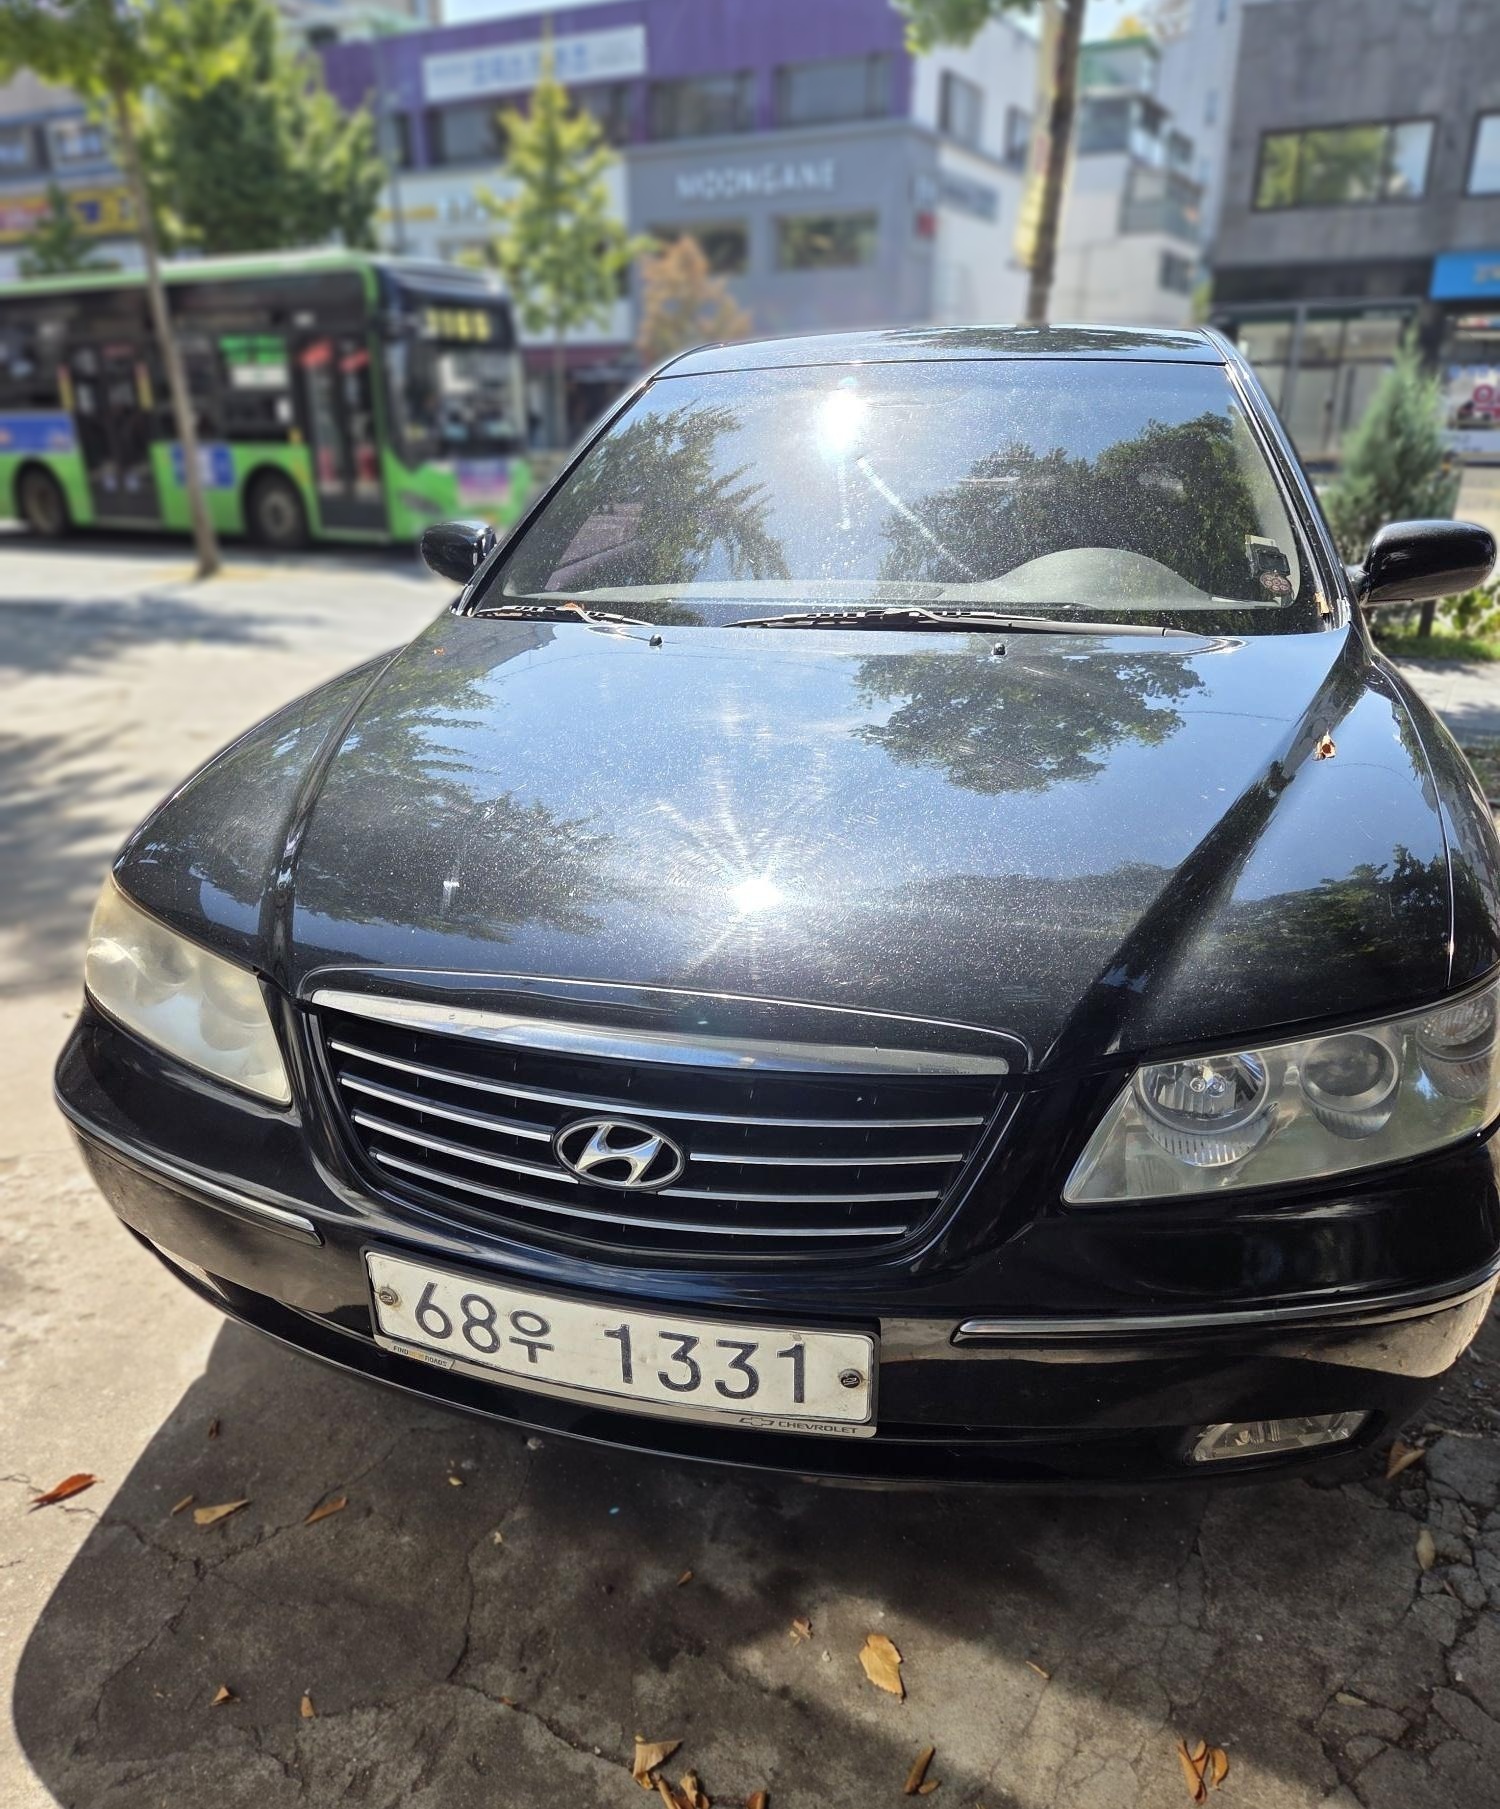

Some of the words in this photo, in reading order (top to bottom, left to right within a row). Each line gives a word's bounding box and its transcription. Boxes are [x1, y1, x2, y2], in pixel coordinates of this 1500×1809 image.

[415, 1281, 555, 1363] 68우
[604, 1323, 806, 1404] 1331
[393, 1345, 409, 1355] FIND
[778, 1421, 858, 1434] CHEVROLET
